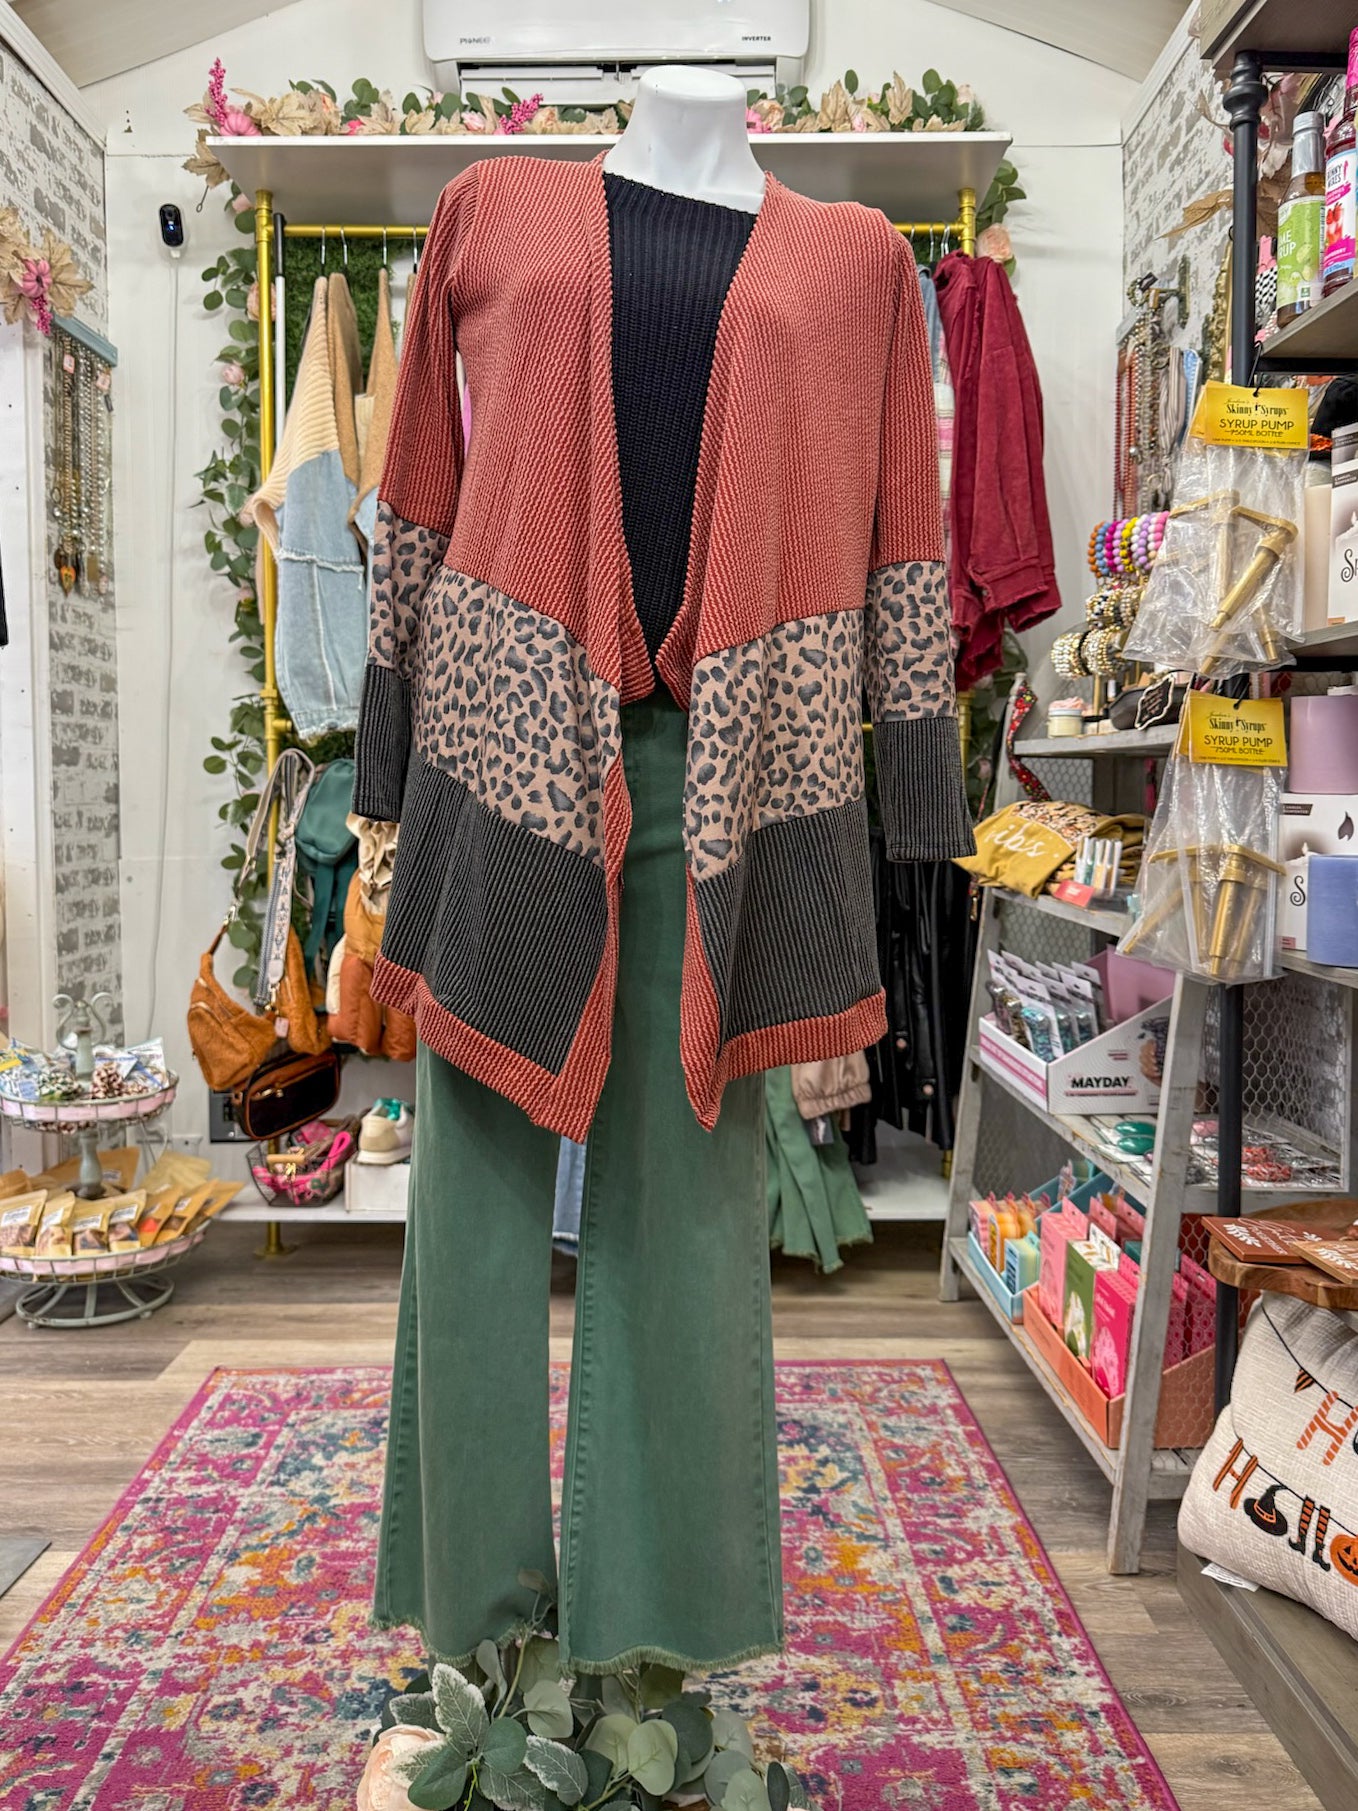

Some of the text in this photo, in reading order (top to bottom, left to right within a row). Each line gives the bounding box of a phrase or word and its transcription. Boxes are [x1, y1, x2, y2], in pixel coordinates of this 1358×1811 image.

[1226, 404, 1289, 417] Skinny Syrups
[1219, 418, 1295, 431] SYRUP PUMP
[1255, 430, 1284, 438] BOTTLE
[1208, 717, 1267, 734] Skinny Syrups
[1204, 734, 1273, 748] SYRUP PUMP
[1238, 747, 1265, 755] BOTTLE
[1070, 1076, 1130, 1089] MAYDAY
